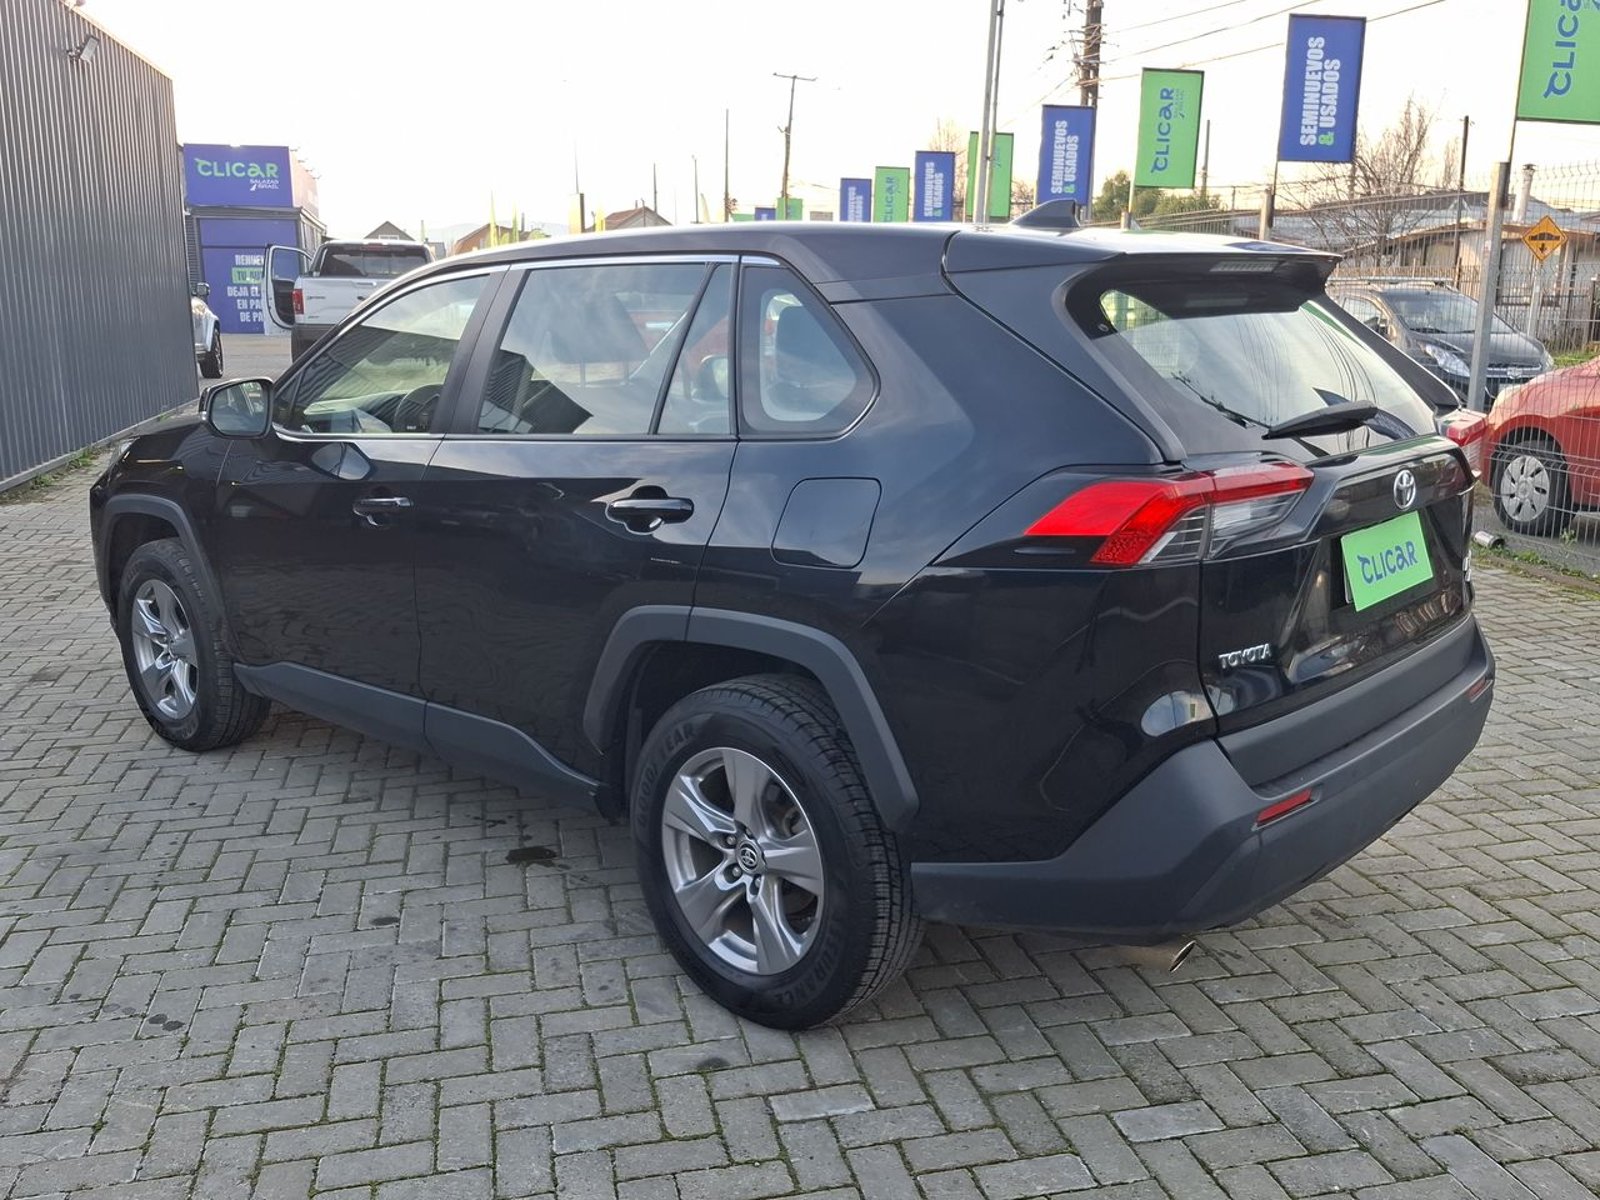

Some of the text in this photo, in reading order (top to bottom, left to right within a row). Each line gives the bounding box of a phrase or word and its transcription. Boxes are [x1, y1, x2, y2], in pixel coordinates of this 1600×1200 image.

[1299, 36, 1326, 146] SEMINUEVOS
[1318, 58, 1341, 146] & USADOS
[1051, 120, 1068, 194] SEMINUEVOS
[1064, 135, 1079, 184] USADOS
[924, 162, 935, 217] SEMINUEVOS
[934, 173, 944, 208] USADOS
[227, 286, 261, 297] DEJA EL
[240, 311, 251, 322] DE
[1218, 643, 1272, 669] TOYOTA
